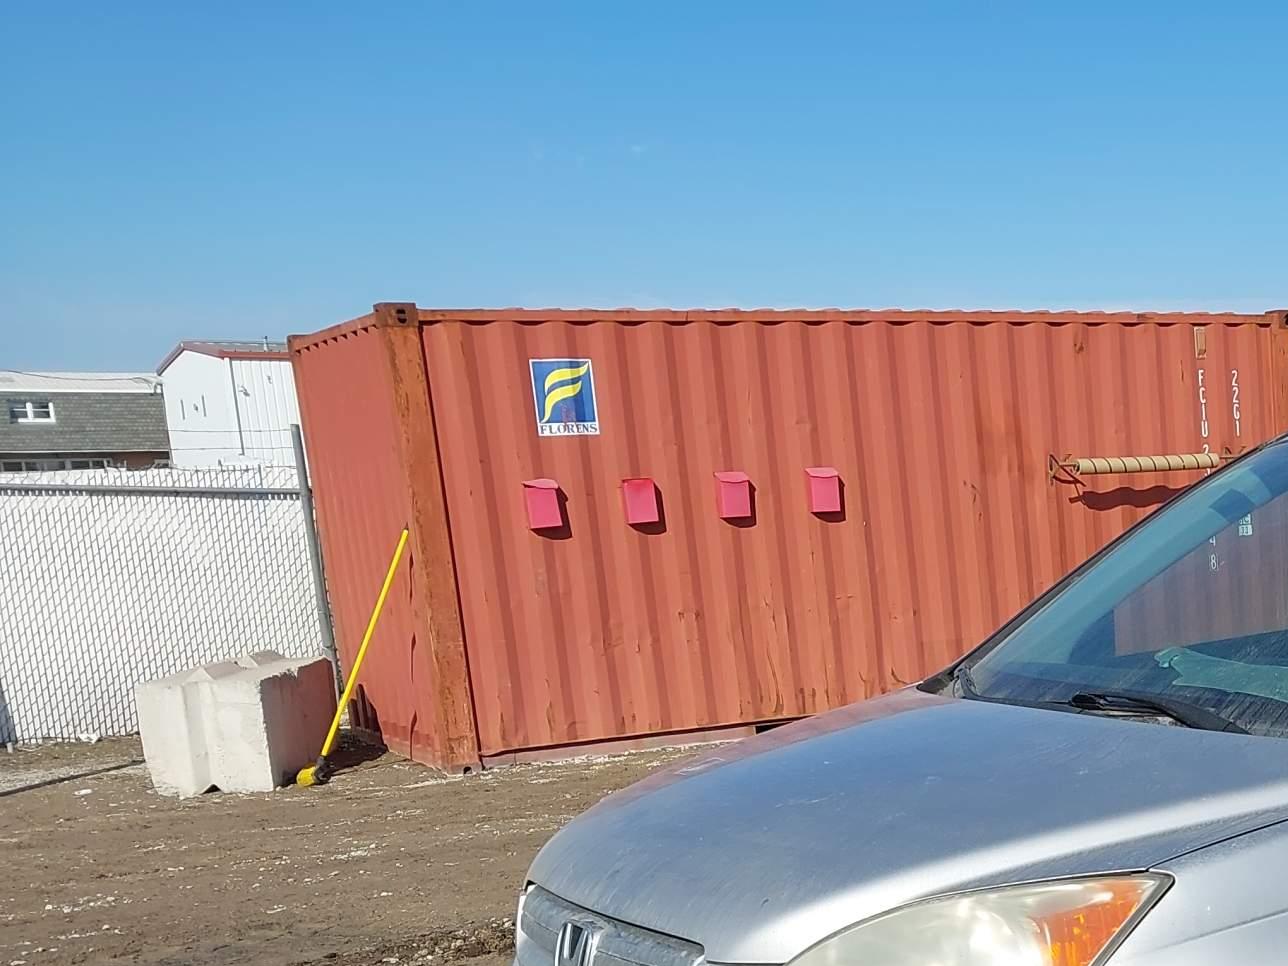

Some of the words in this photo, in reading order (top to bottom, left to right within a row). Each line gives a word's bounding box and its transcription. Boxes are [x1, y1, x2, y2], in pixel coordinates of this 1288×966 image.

[540, 423, 598, 435] FLORENS
[1198, 369, 1209, 438] FCIU
[1231, 369, 1241, 437] 22G1
